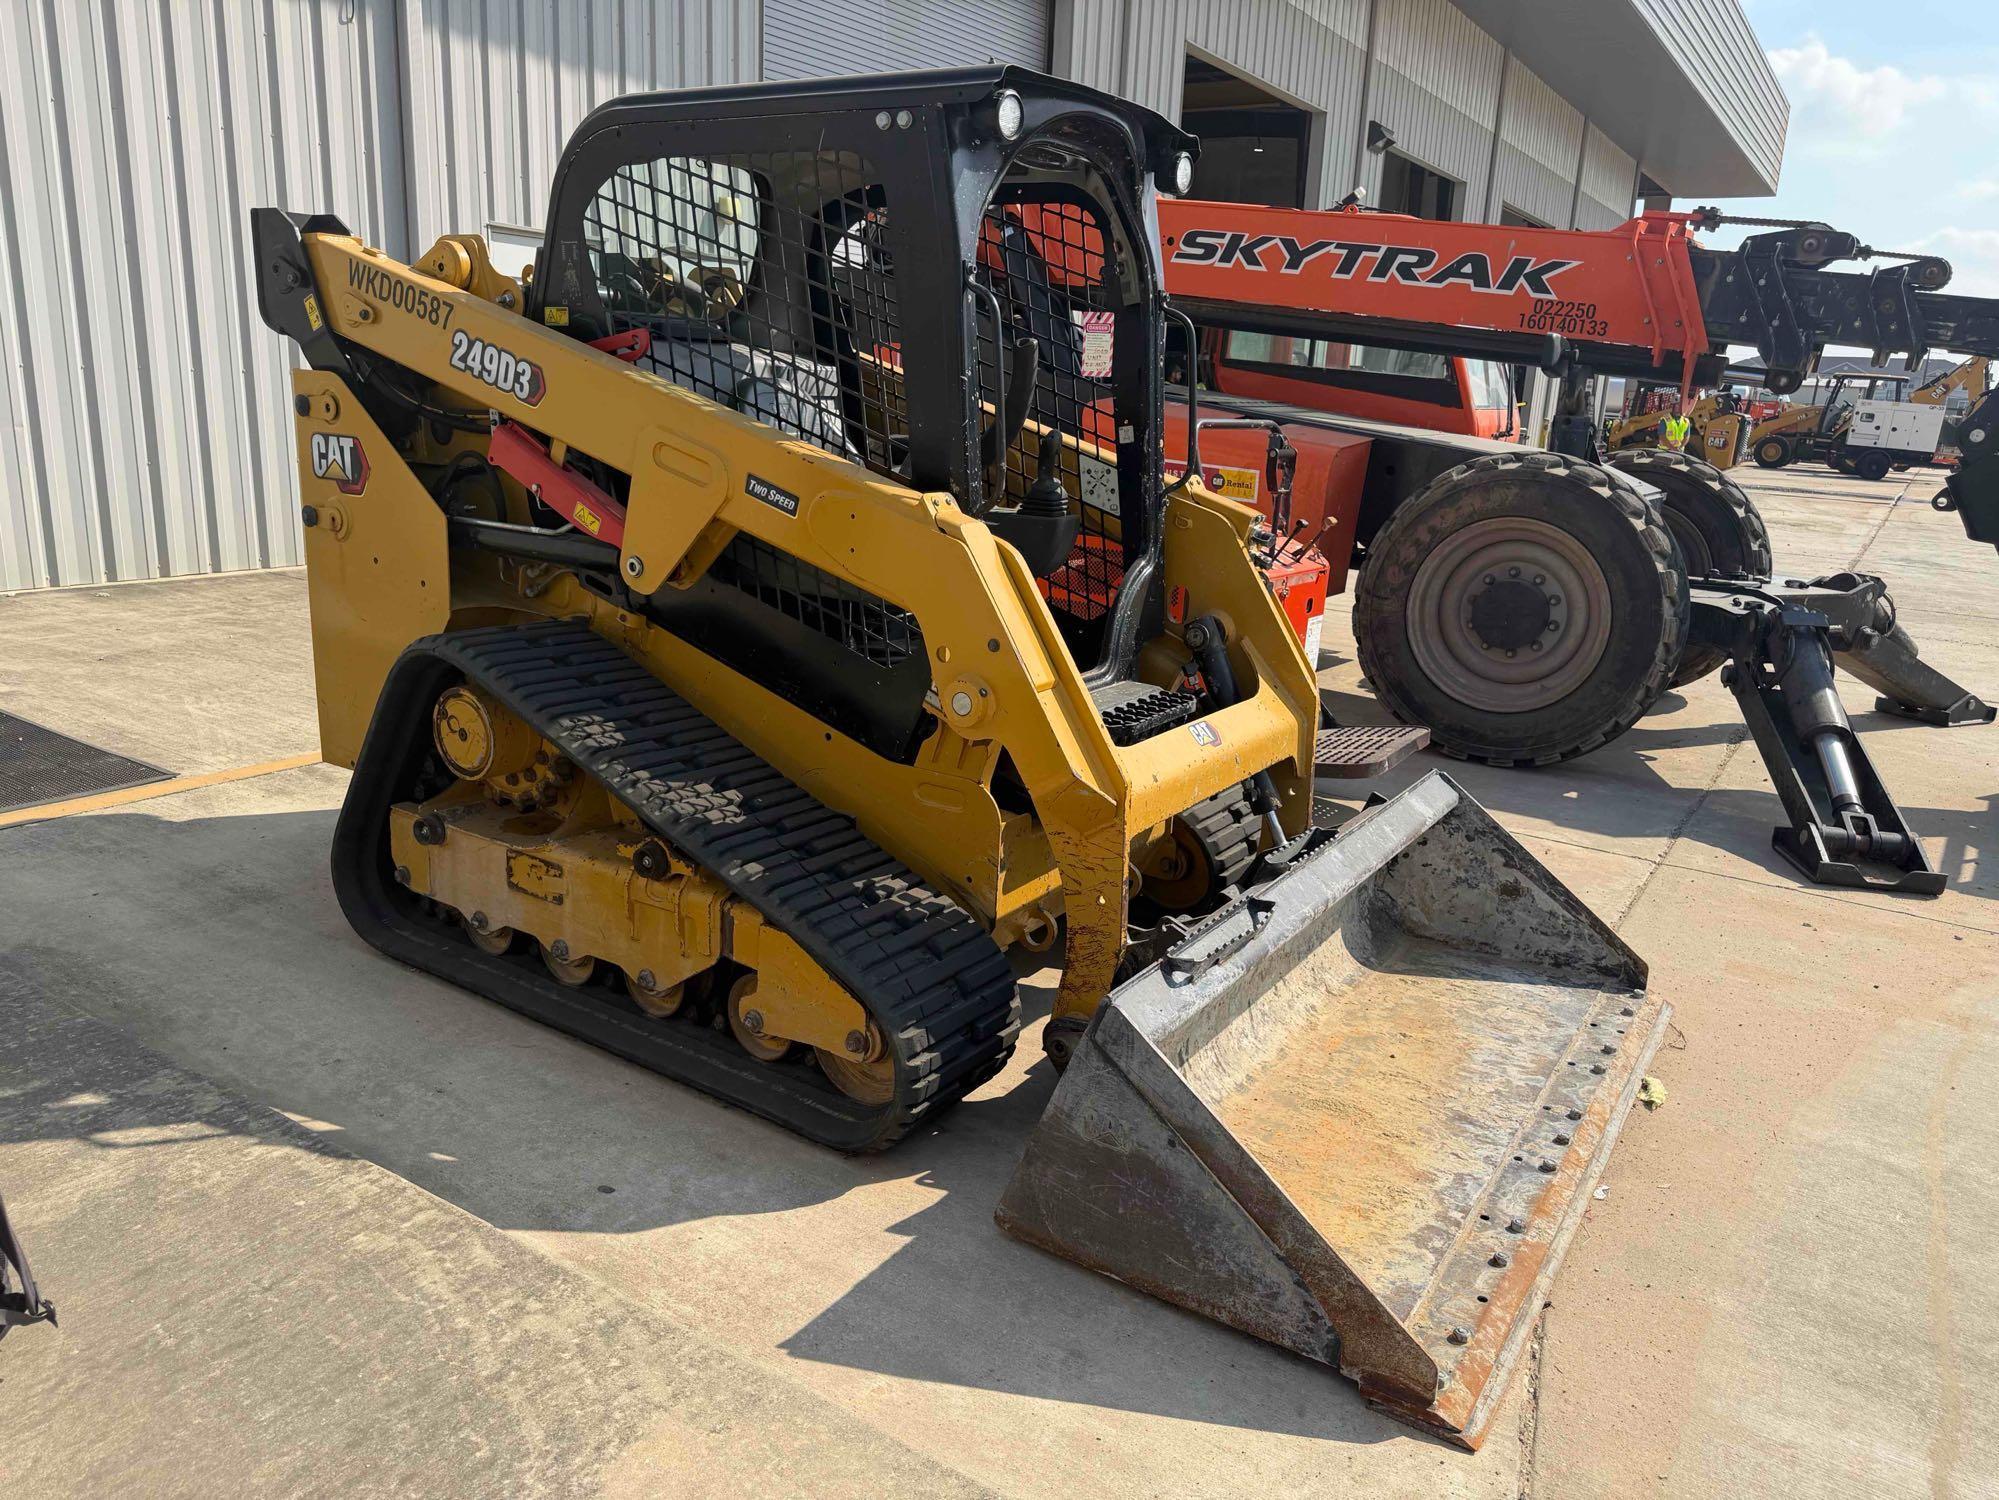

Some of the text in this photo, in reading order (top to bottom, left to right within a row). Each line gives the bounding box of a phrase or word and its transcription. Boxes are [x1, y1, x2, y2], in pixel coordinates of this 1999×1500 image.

[1171, 229, 1584, 299] SKYTRAK
[349, 258, 454, 330] WKD00587
[1533, 299, 1597, 320] 022250
[1519, 313, 1609, 337] 160140133
[450, 331, 532, 399] 249D3
[1931, 385, 1946, 399] CAT
[1708, 437, 1726, 448] CAT
[311, 433, 354, 480] CAT
[1212, 477, 1253, 489] CAT Rental
[1189, 721, 1215, 746] CAT
